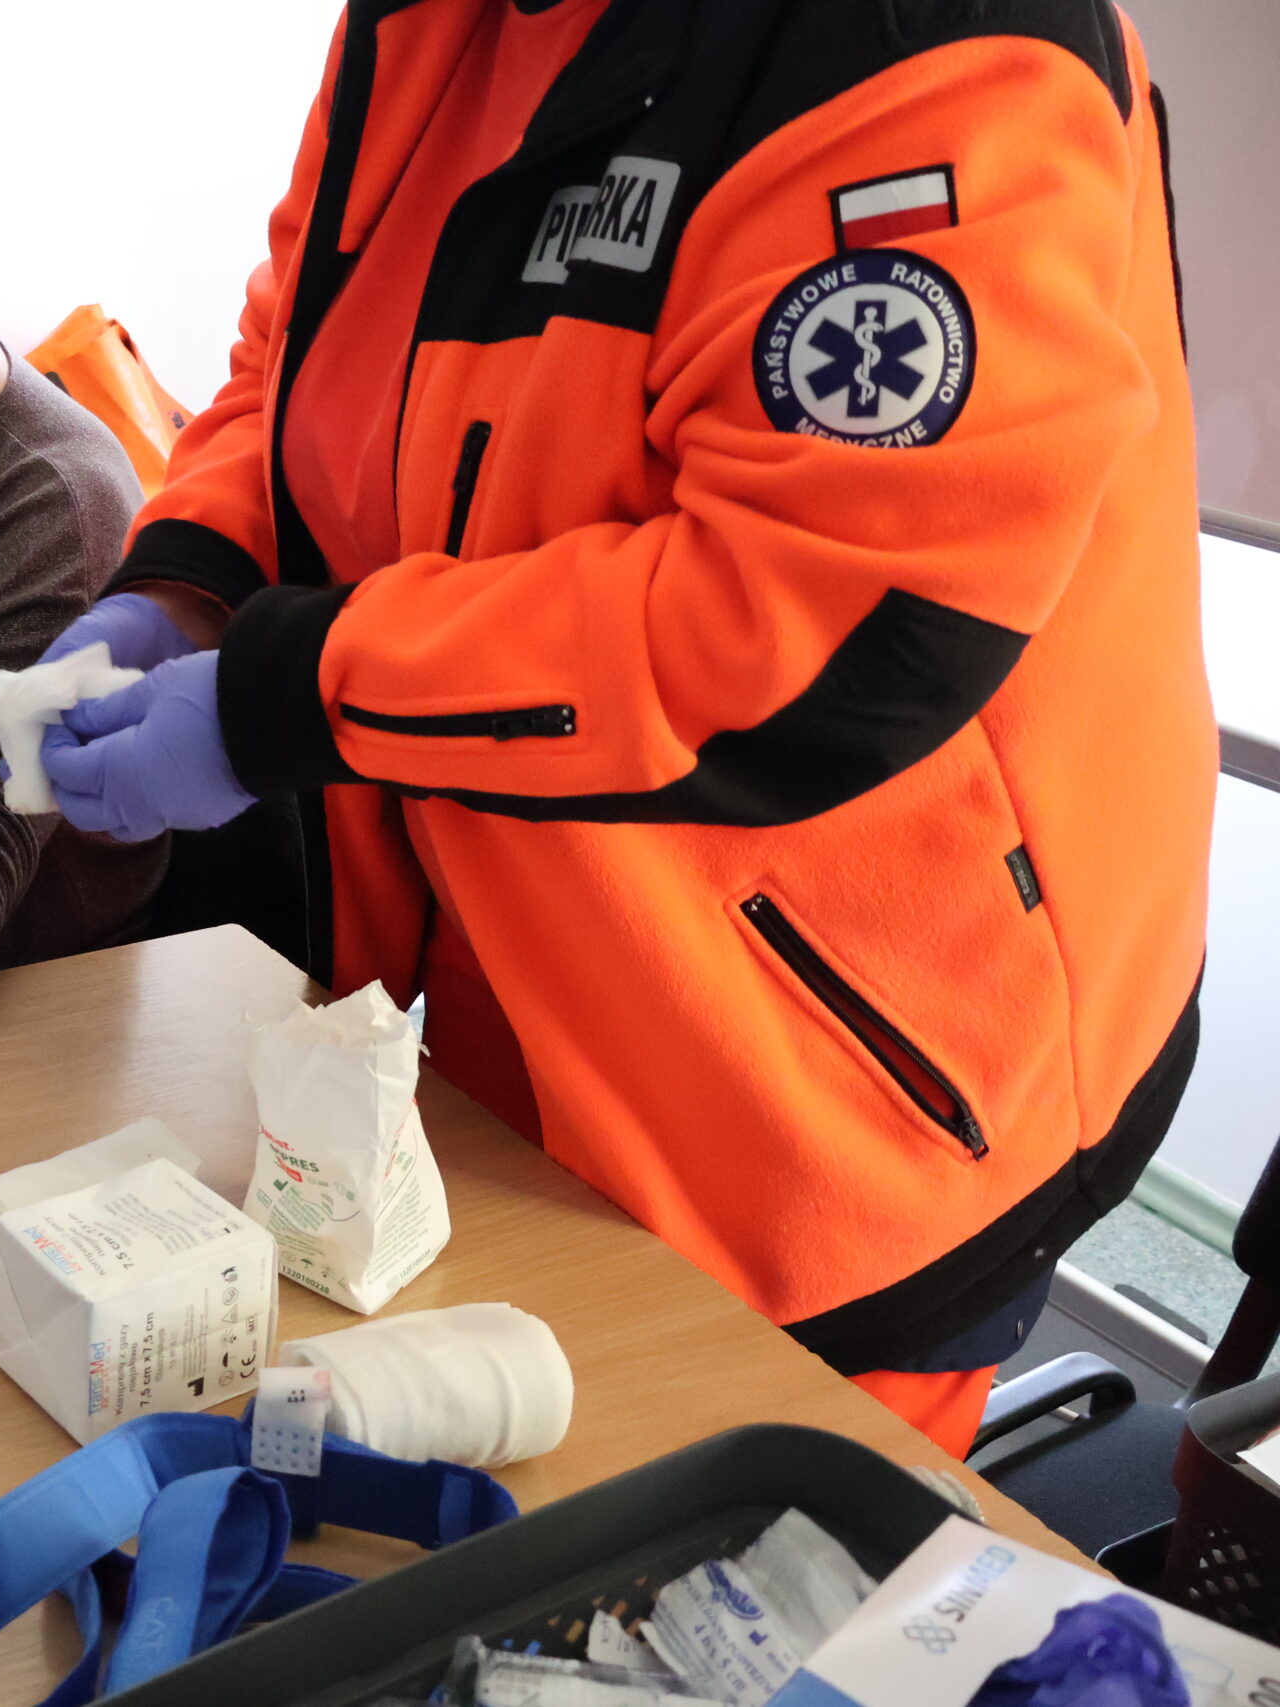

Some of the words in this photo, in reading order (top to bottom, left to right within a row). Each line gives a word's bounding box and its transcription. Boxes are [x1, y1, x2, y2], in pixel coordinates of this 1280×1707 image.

[764, 263, 858, 400] PAŃSTWOWE
[890, 262, 964, 404] RATOWNICTWO
[795, 415, 928, 448] MZNE
[145, 1311, 155, 1332] cm
[143, 1366, 152, 1386] cm
[933, 1544, 1017, 1623] SINMED
